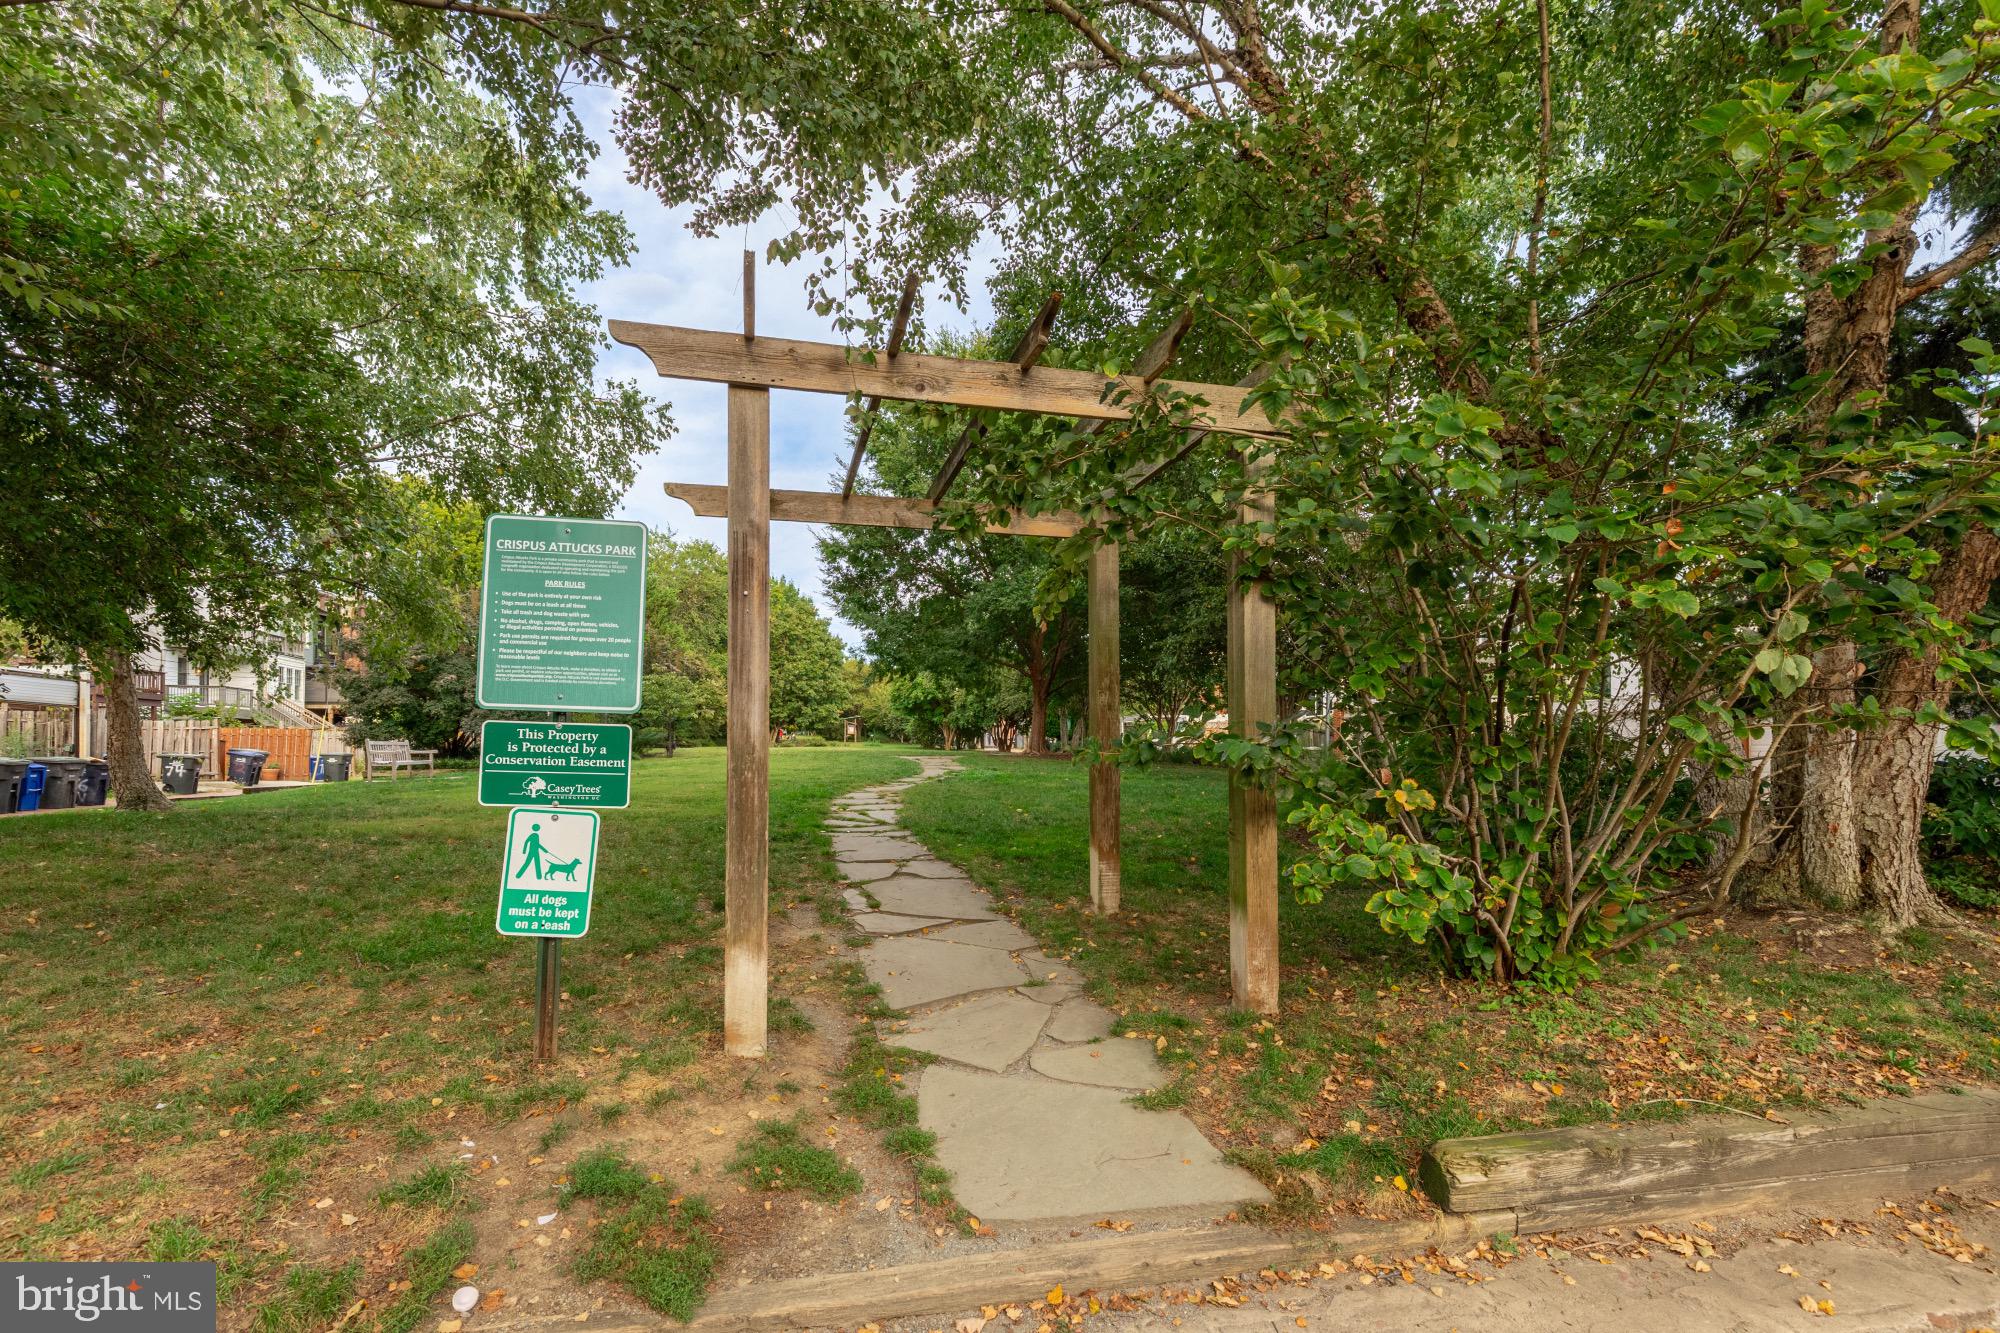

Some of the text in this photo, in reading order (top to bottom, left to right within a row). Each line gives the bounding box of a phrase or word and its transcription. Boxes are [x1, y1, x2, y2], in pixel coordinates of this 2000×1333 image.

[496, 539, 637, 556] CRISPUS ATTUCKS PARK
[545, 580, 586, 589] PARK RULES
[517, 728, 598, 743] This Property
[508, 742, 518, 752] is
[522, 742, 579, 754] Protected
[582, 744, 596, 757] by
[486, 754, 625, 768] Conservation Easement
[547, 784, 576, 794] Casey
[524, 894, 567, 907] All dogs
[508, 906, 579, 920] must be kept
[515, 920, 528, 929] on
[531, 921, 538, 929] a
